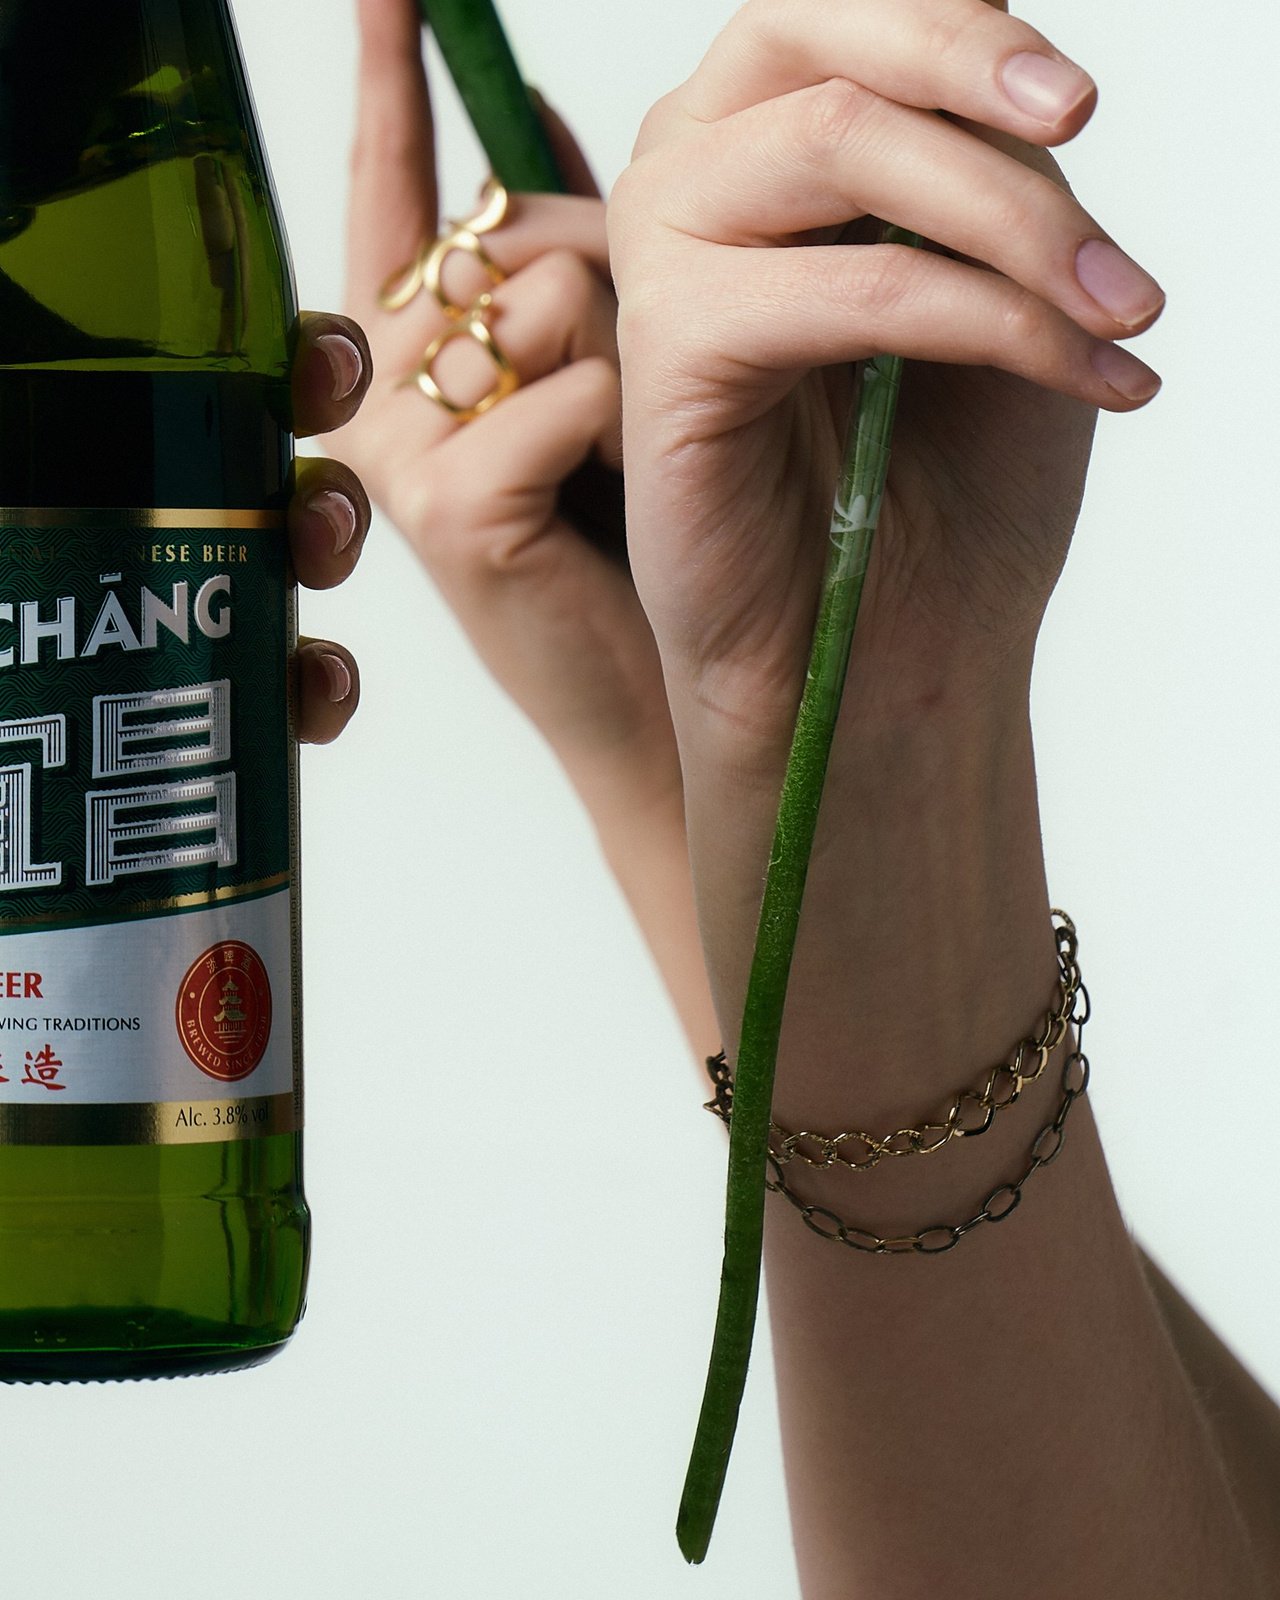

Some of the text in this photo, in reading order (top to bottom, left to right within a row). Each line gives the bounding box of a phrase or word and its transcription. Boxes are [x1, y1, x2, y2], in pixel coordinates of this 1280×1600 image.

[202, 544, 248, 563] BEER
[43, 1017, 141, 1031] TRADITIONS
[187, 1019, 221, 1067] BREWED
[175, 1101, 269, 1127] Alc. 3.8% vol
